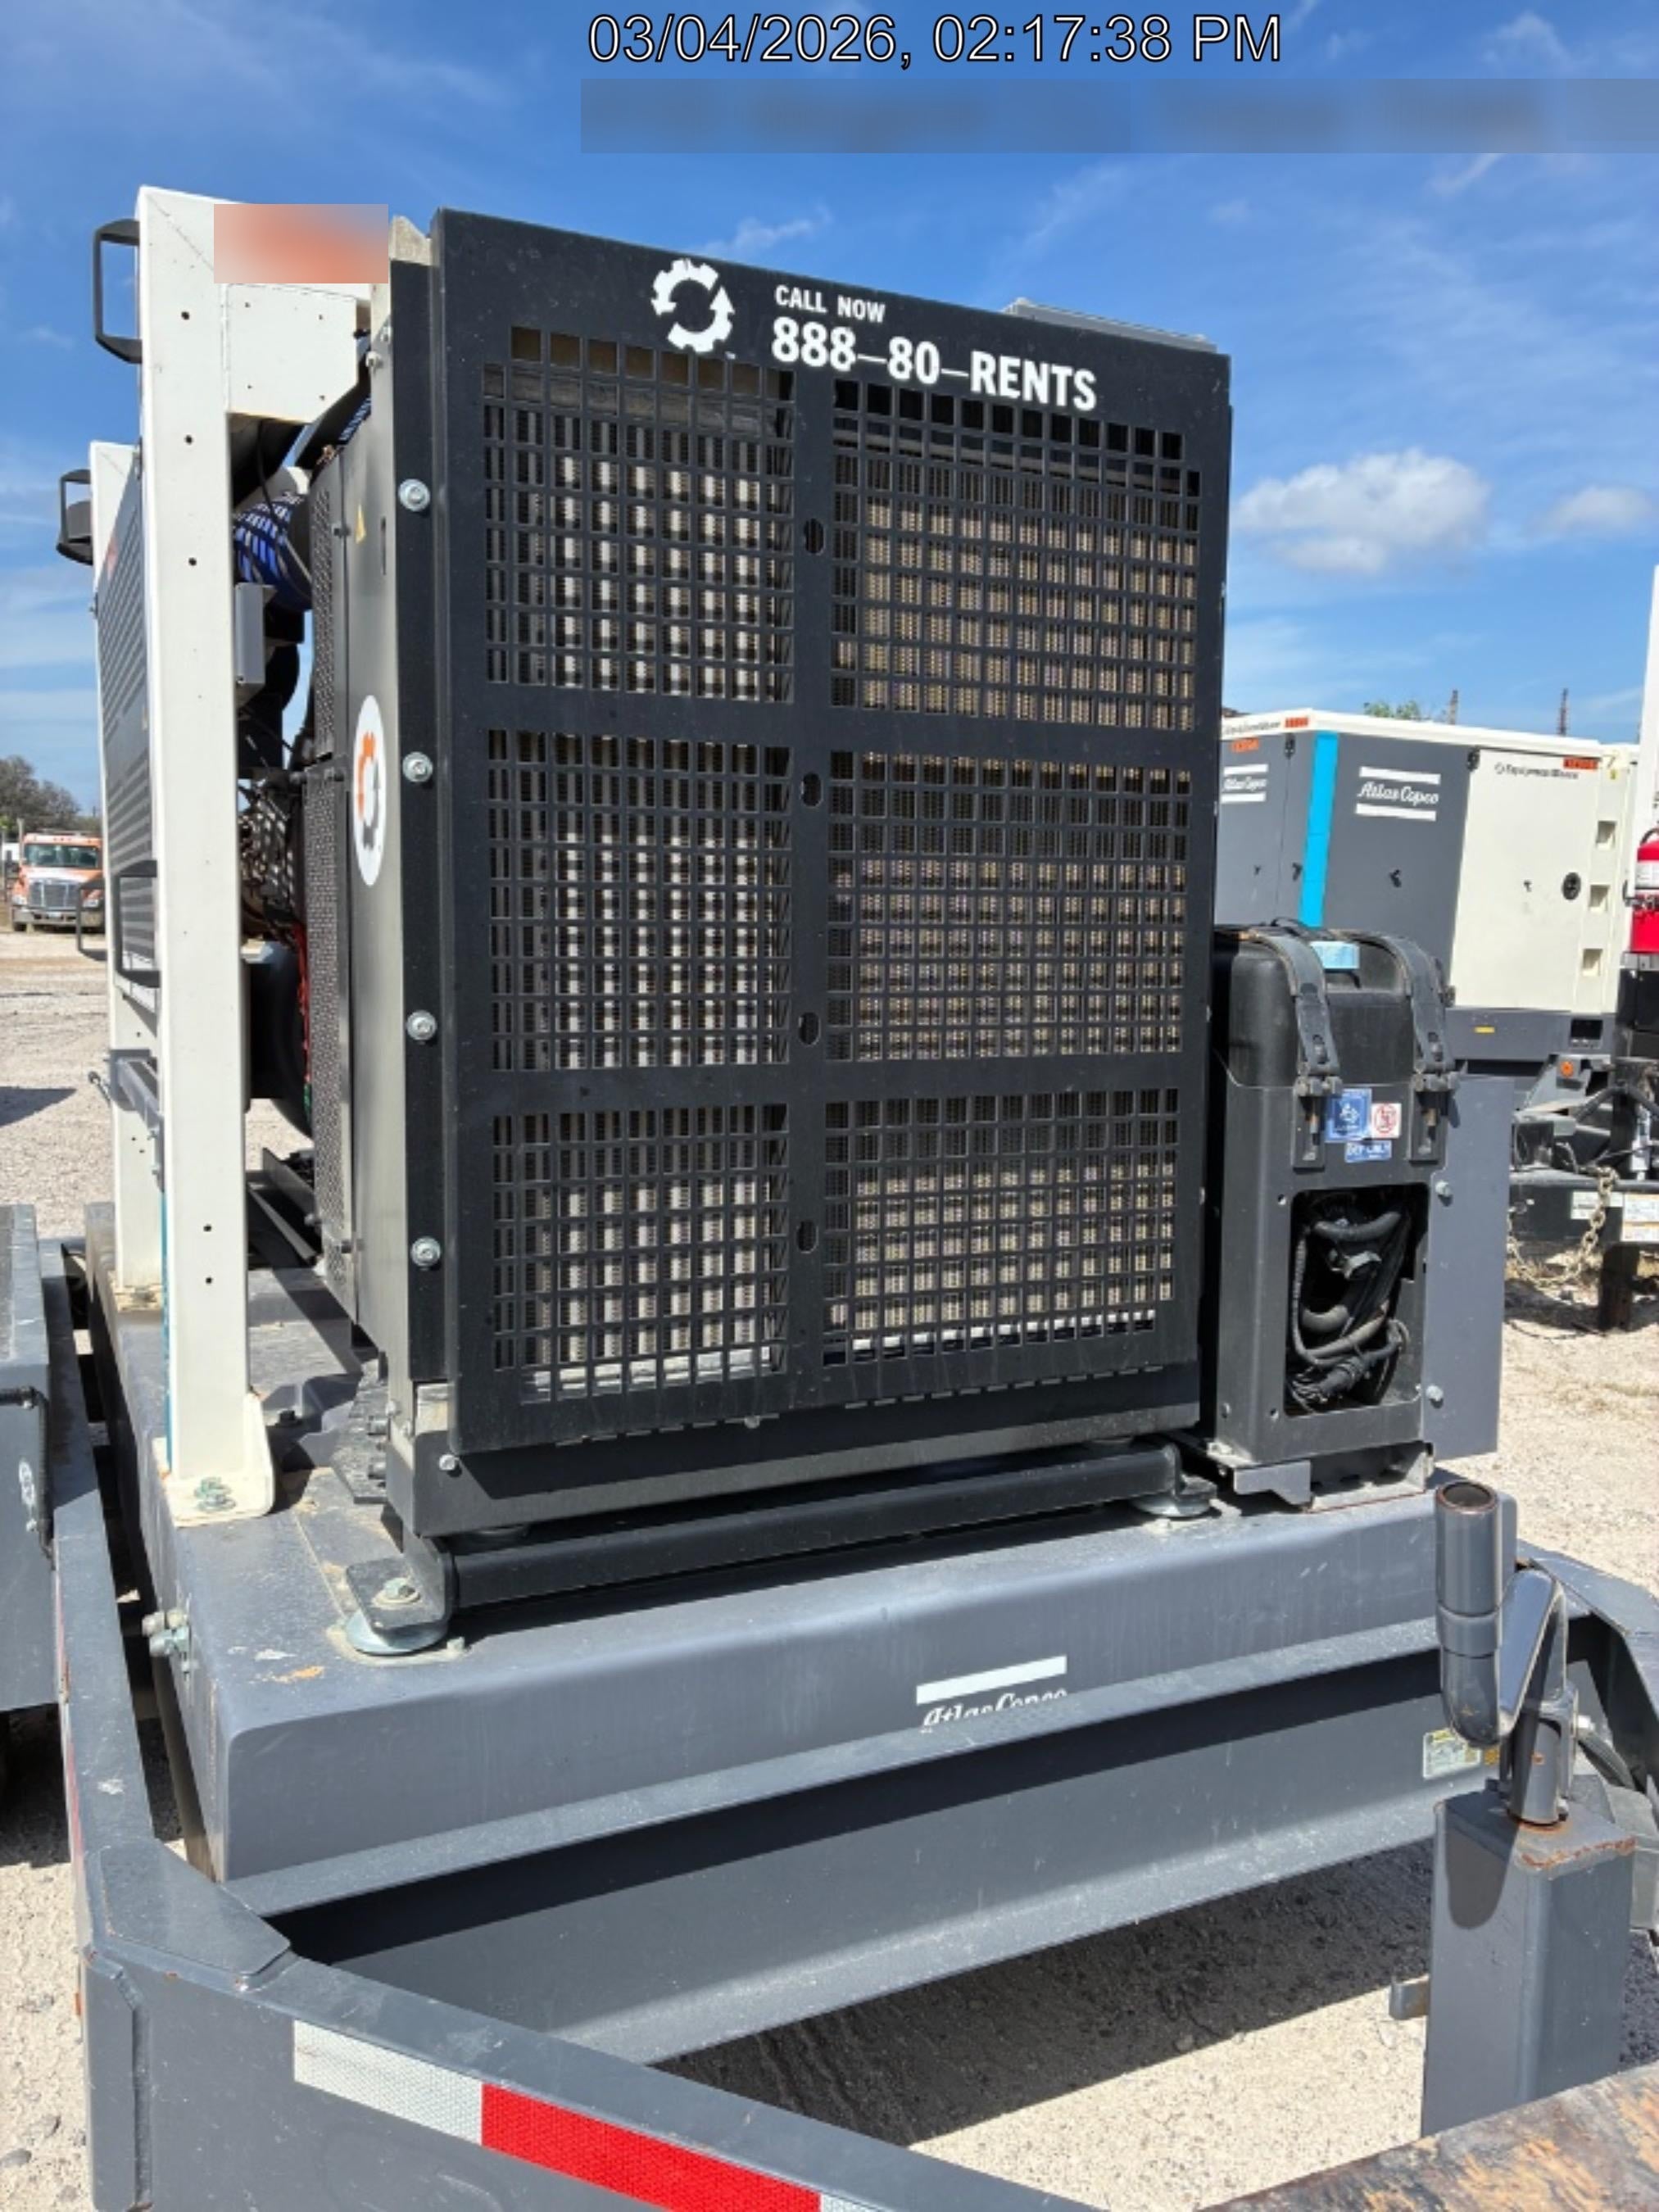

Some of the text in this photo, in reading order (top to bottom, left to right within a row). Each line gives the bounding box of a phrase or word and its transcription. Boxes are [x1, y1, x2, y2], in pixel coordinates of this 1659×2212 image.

[775, 284, 886, 323] CALL NOW
[771, 315, 1097, 410] 888-80-RENTS
[1357, 780, 1439, 806] Atlas Copco
